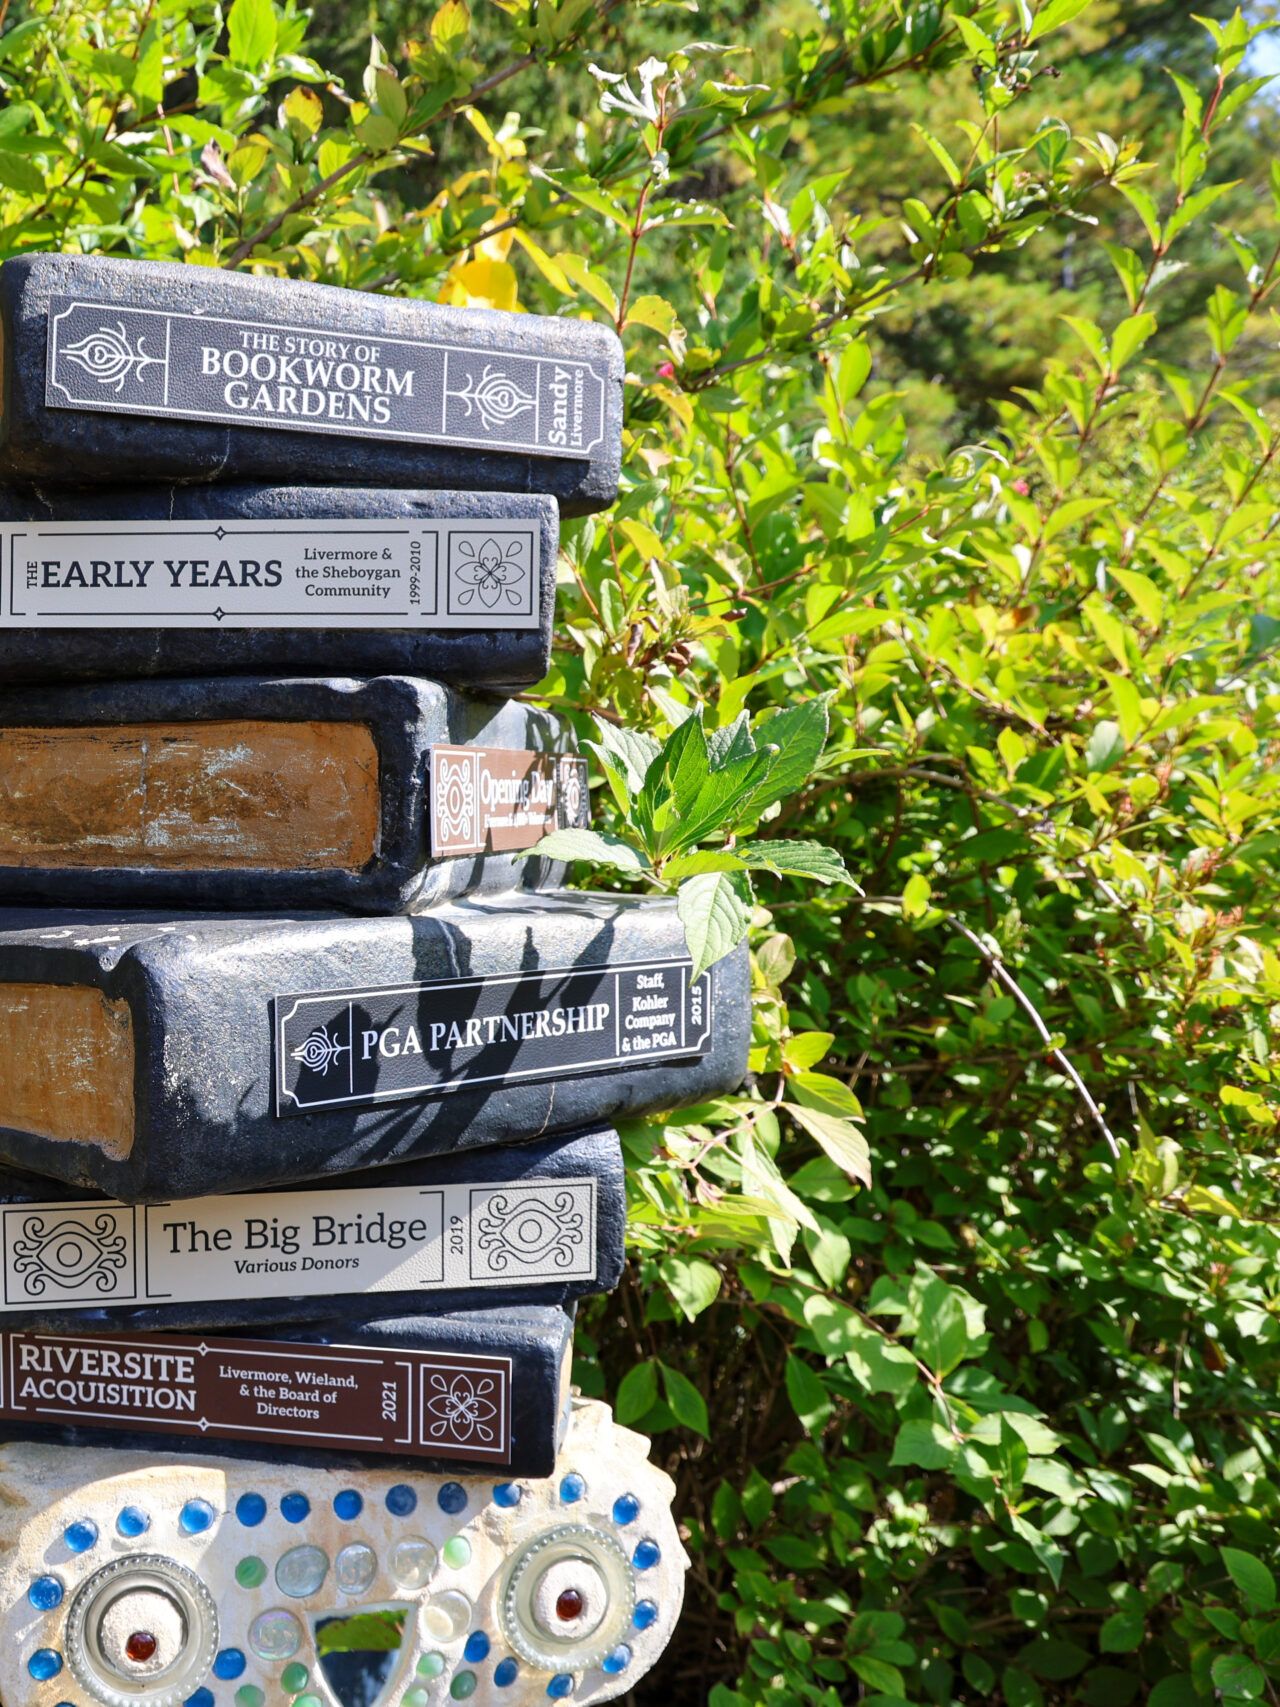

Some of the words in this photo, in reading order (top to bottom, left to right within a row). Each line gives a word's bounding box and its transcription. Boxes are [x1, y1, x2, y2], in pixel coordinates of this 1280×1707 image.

[240, 331, 279, 351] THE
[285, 337, 350, 360] STORY
[355, 345, 380, 363] OF
[201, 346, 415, 396] BOOKWORM
[224, 381, 391, 424] GARDENS
[548, 366, 572, 445] Sandy
[570, 369, 584, 446] Livermore
[304, 548, 378, 560] Livermore
[381, 547, 392, 560] &
[26, 561, 38, 588] THE
[41, 560, 154, 588] EARLY
[163, 560, 283, 588] YEARS
[295, 566, 319, 578] the
[322, 566, 401, 580] Sheboygan
[409, 541, 421, 605] 1999-2010
[305, 584, 391, 598] Community
[480, 769, 530, 812] Opening
[531, 771, 554, 809] Day
[636, 972, 665, 989] Staff,
[632, 994, 669, 1012] Kohler
[691, 985, 702, 1025] 2015
[361, 1026, 423, 1060] PGA
[429, 1003, 610, 1051] PARTNERSHIP
[625, 1013, 676, 1030] Company
[622, 1037, 631, 1052] &
[633, 1035, 651, 1050] the
[652, 1031, 677, 1048] PGA
[163, 1221, 232, 1253] The
[244, 1218, 300, 1254] Big
[312, 1212, 427, 1249] Bridge
[450, 1215, 463, 1255] 2019
[234, 1259, 297, 1274] Various
[301, 1256, 360, 1272] Donors
[19, 1344, 195, 1383] RIVERSITE
[219, 1365, 292, 1384] Livermore,
[295, 1371, 358, 1389] Wieland,
[19, 1377, 197, 1411] ACQUISITION
[239, 1384, 249, 1396] &
[253, 1385, 276, 1398] the
[279, 1387, 319, 1402] Board
[323, 1391, 337, 1403] of
[382, 1381, 397, 1422] 2021
[256, 1402, 320, 1419] Directors
